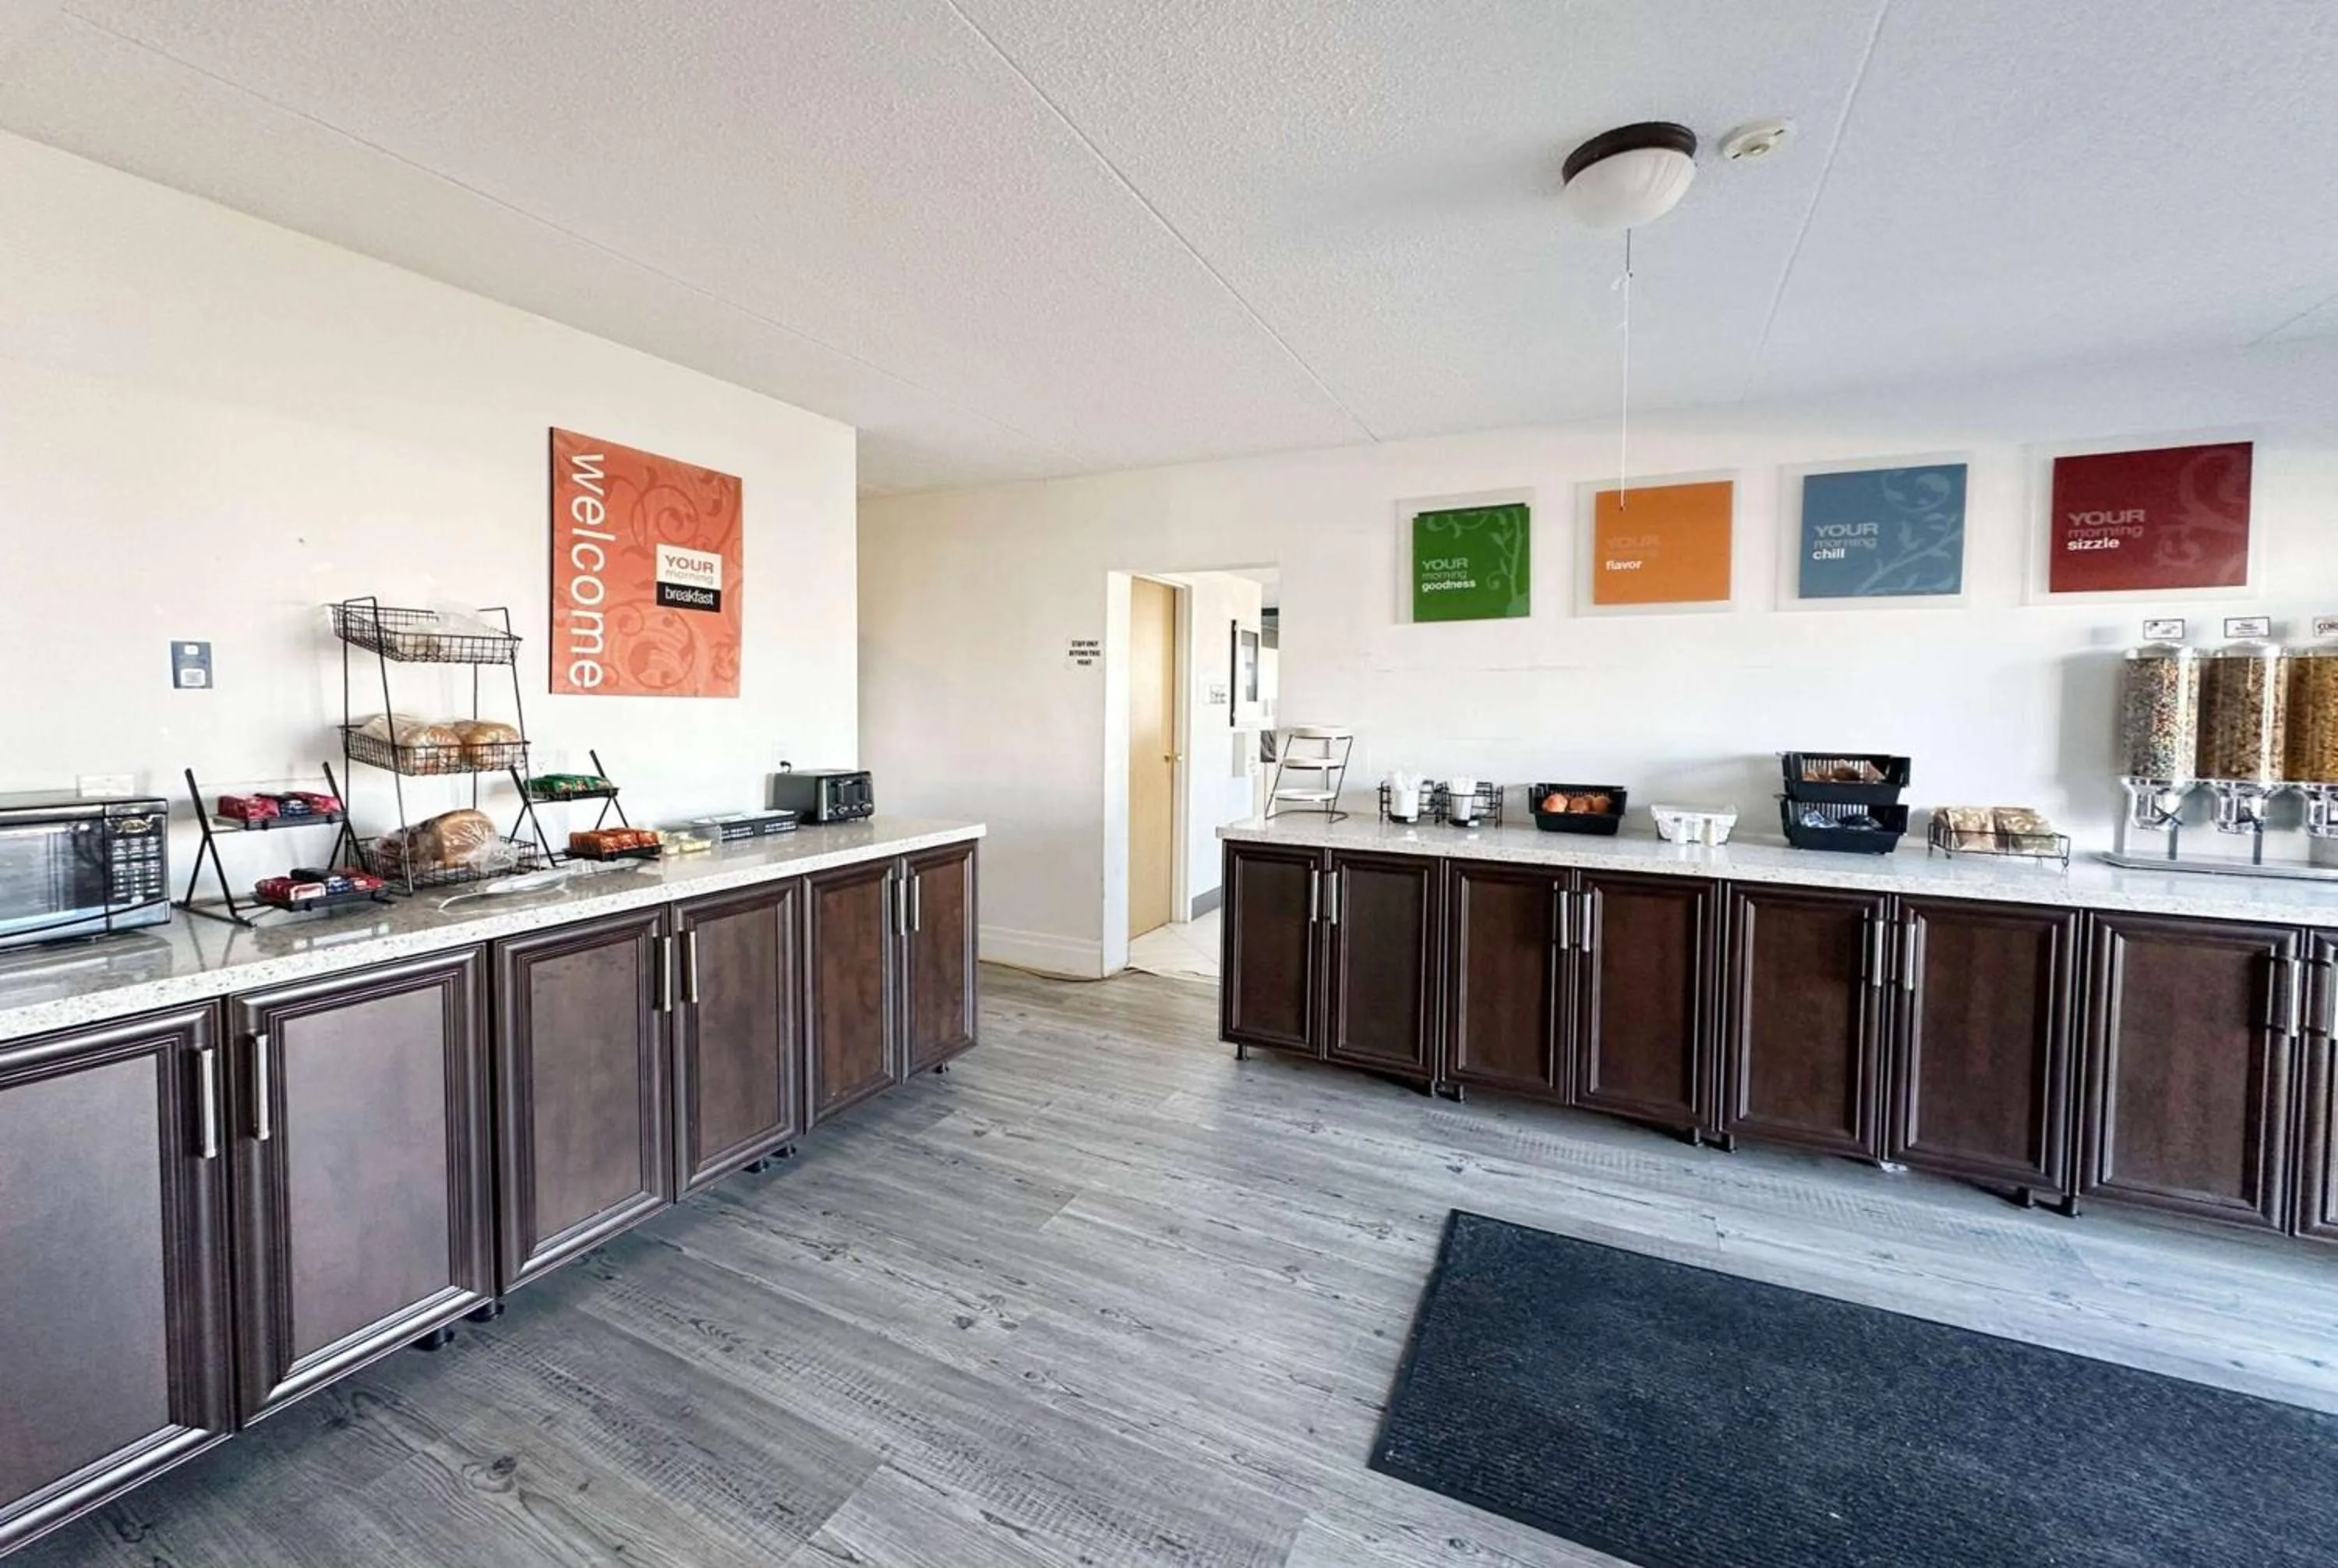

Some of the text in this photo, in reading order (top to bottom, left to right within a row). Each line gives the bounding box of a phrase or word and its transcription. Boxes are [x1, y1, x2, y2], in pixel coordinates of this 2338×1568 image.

[2068, 509, 2145, 526] YOUR
[1814, 522, 1878, 537] YOUR
[2068, 526, 2143, 539] morning
[2067, 536, 2120, 550] sizzle
[1812, 548, 1845, 560] chill
[665, 554, 714, 574] YOUR
[1422, 557, 1469, 570] YOUR
[1605, 560, 1643, 570] flavor
[567, 454, 616, 689] welcome
[665, 569, 714, 586] morning
[1422, 579, 1476, 592] goodness
[665, 586, 714, 605] breakfast
